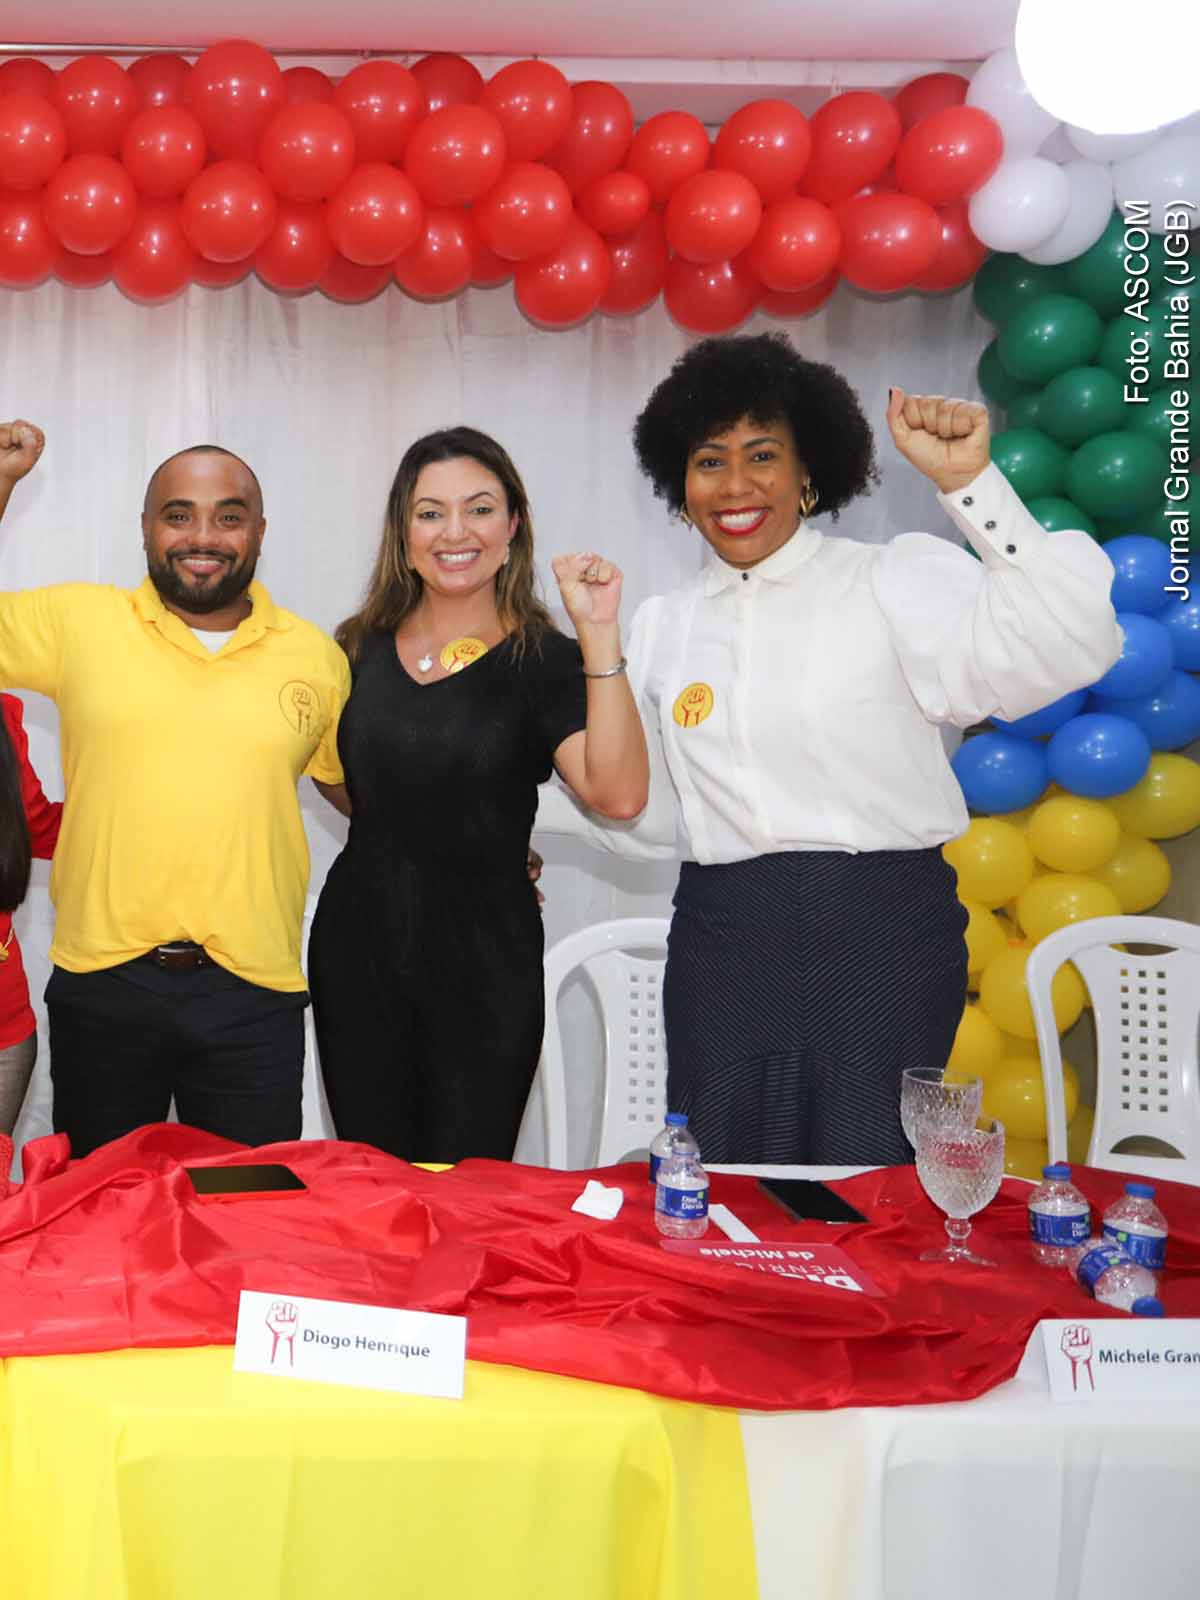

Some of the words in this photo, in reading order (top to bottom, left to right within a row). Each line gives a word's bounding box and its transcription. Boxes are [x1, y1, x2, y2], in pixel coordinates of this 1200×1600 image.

[699, 1247, 784, 1259] Michele
[786, 1250, 815, 1260] de
[303, 1328, 351, 1349] Diogo
[355, 1335, 431, 1358] Henrique
[1099, 1348, 1160, 1364] Michele
